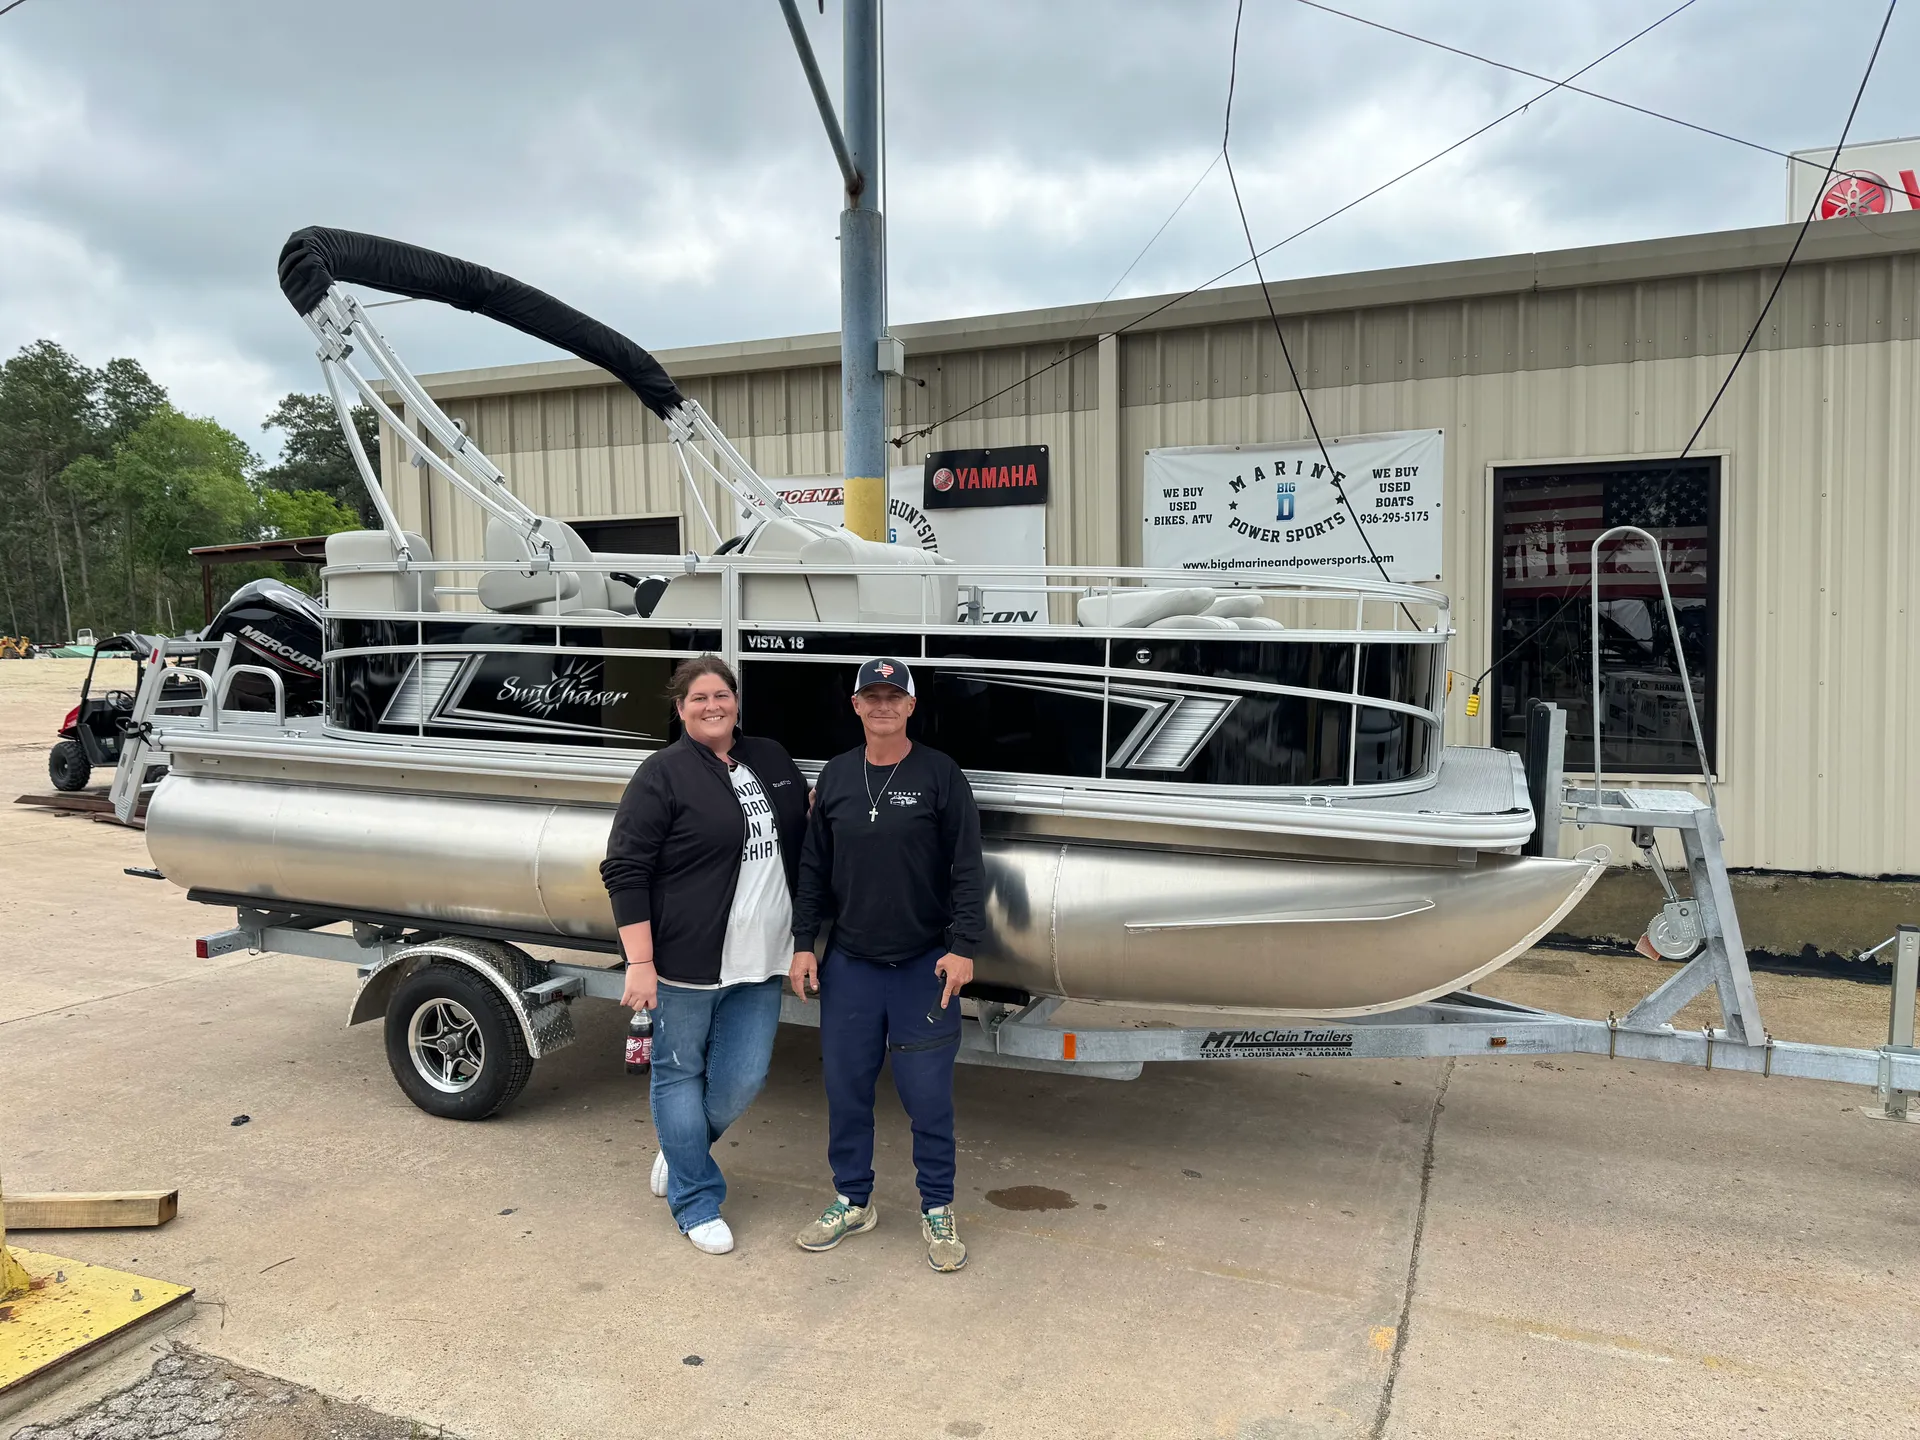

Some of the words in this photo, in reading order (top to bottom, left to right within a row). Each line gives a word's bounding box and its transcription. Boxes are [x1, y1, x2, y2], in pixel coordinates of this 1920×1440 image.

[956, 464, 1038, 490] YAMAHA
[1228, 460, 1347, 494] MARINE
[1372, 468, 1391, 479] WE
[1395, 466, 1419, 477] BUY
[1163, 488, 1180, 498] WE
[1183, 487, 1204, 497] BUY
[1276, 482, 1296, 493] BIG
[1379, 481, 1411, 493] USED
[776, 487, 844, 504] HOENIX
[1375, 496, 1414, 508] BOATS
[1169, 501, 1197, 511] USED
[1276, 493, 1295, 521] D
[1192, 514, 1213, 524] ATV
[1360, 511, 1429, 524] 936-295-5175
[889, 498, 939, 554] HUNTSVI
[1228, 516, 1280, 543] POWER
[1286, 511, 1346, 543] SPORTS
[1182, 554, 1394, 571] www.bigdmarineandpowersports.com
[239, 625, 323, 671] MERCURY
[747, 635, 786, 649] VISTA
[788, 636, 805, 650] 18
[496, 676, 630, 707] SunChaser
[1240, 1030, 1299, 1043] McClain
[1303, 1030, 1353, 1042] Trailers
